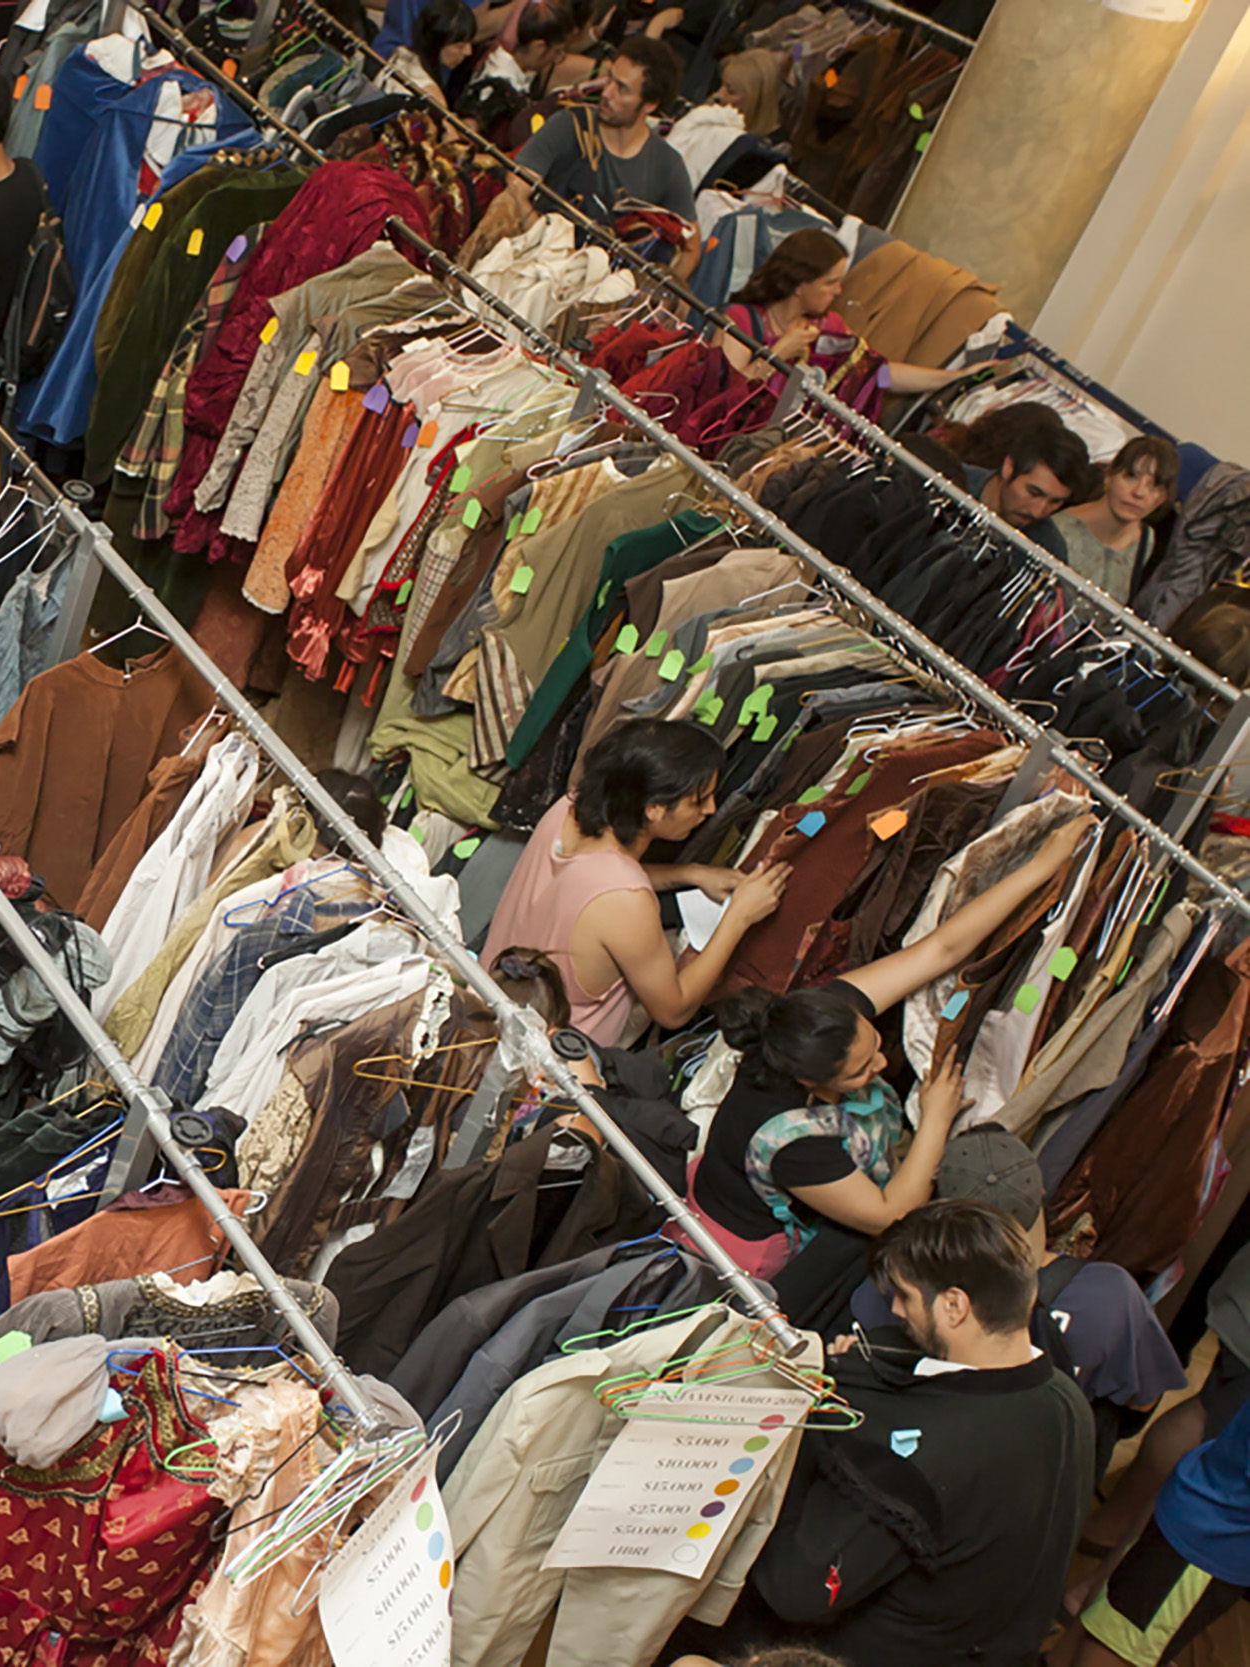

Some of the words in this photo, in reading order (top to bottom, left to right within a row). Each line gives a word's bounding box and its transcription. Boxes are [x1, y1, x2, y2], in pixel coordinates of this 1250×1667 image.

[673, 1434, 730, 1447] $5.000
[655, 1457, 718, 1470] $10.000
[642, 1480, 703, 1493] $15.000
